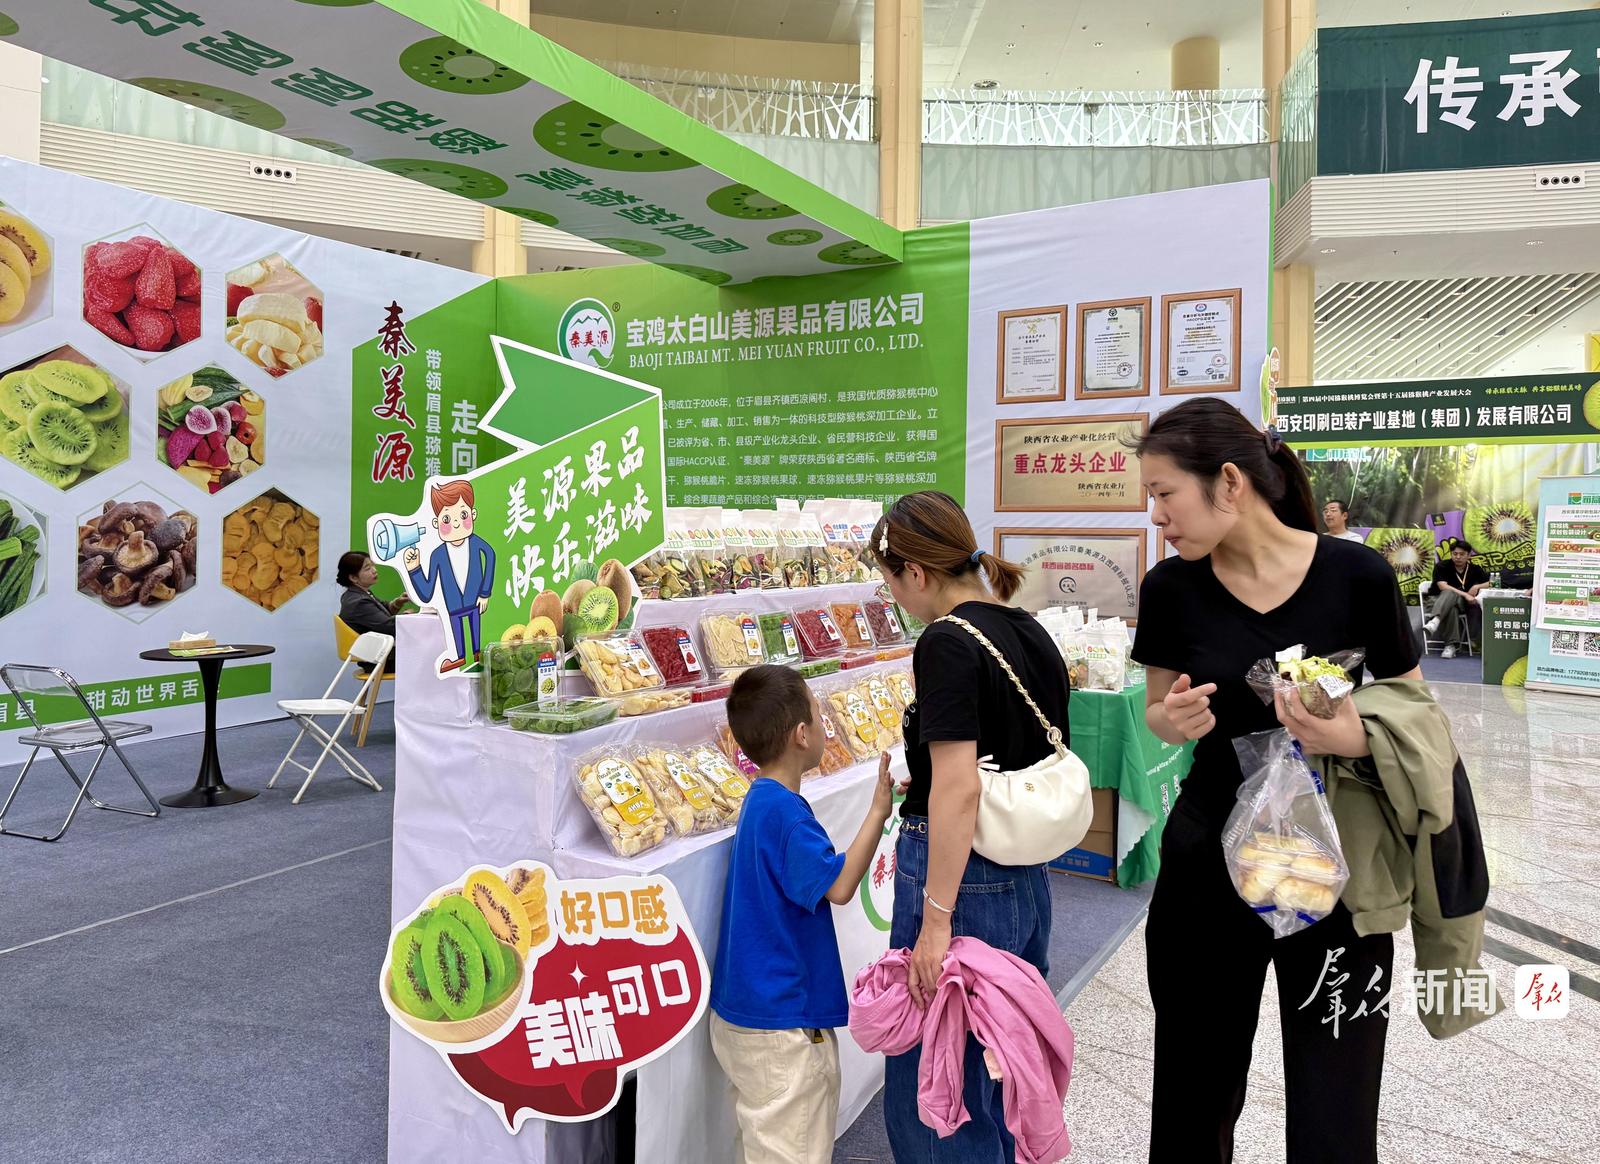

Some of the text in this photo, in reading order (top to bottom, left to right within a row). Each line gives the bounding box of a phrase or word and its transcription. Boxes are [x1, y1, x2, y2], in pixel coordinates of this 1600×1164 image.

[1403, 48, 1600, 134] 传承
[515, 166, 749, 256] 眉县猕猴桃
[568, 330, 609, 347] 秦美源
[626, 293, 924, 347] 宝鸡太白山美源果品有限公司
[629, 333, 924, 370] BAOJI TAIBAI MT. MEI YUAN FRUIT CO., LTD.
[372, 300, 416, 482] 秦美源
[425, 348, 442, 476] 带领眉县猕猴
[452, 399, 478, 473] 走向
[1024, 432, 1117, 444] 陕西省农业产业化经营
[1276, 404, 1572, 433] 西安印刷包装产业基地（集团）发展有限公司
[503, 425, 645, 542] 美源果品
[1013, 451, 1127, 474] 重点龙头企业
[506, 492, 652, 608] 快乐滋味
[87, 678, 219, 710] 甜动世界舌
[560, 884, 670, 935] 好口感
